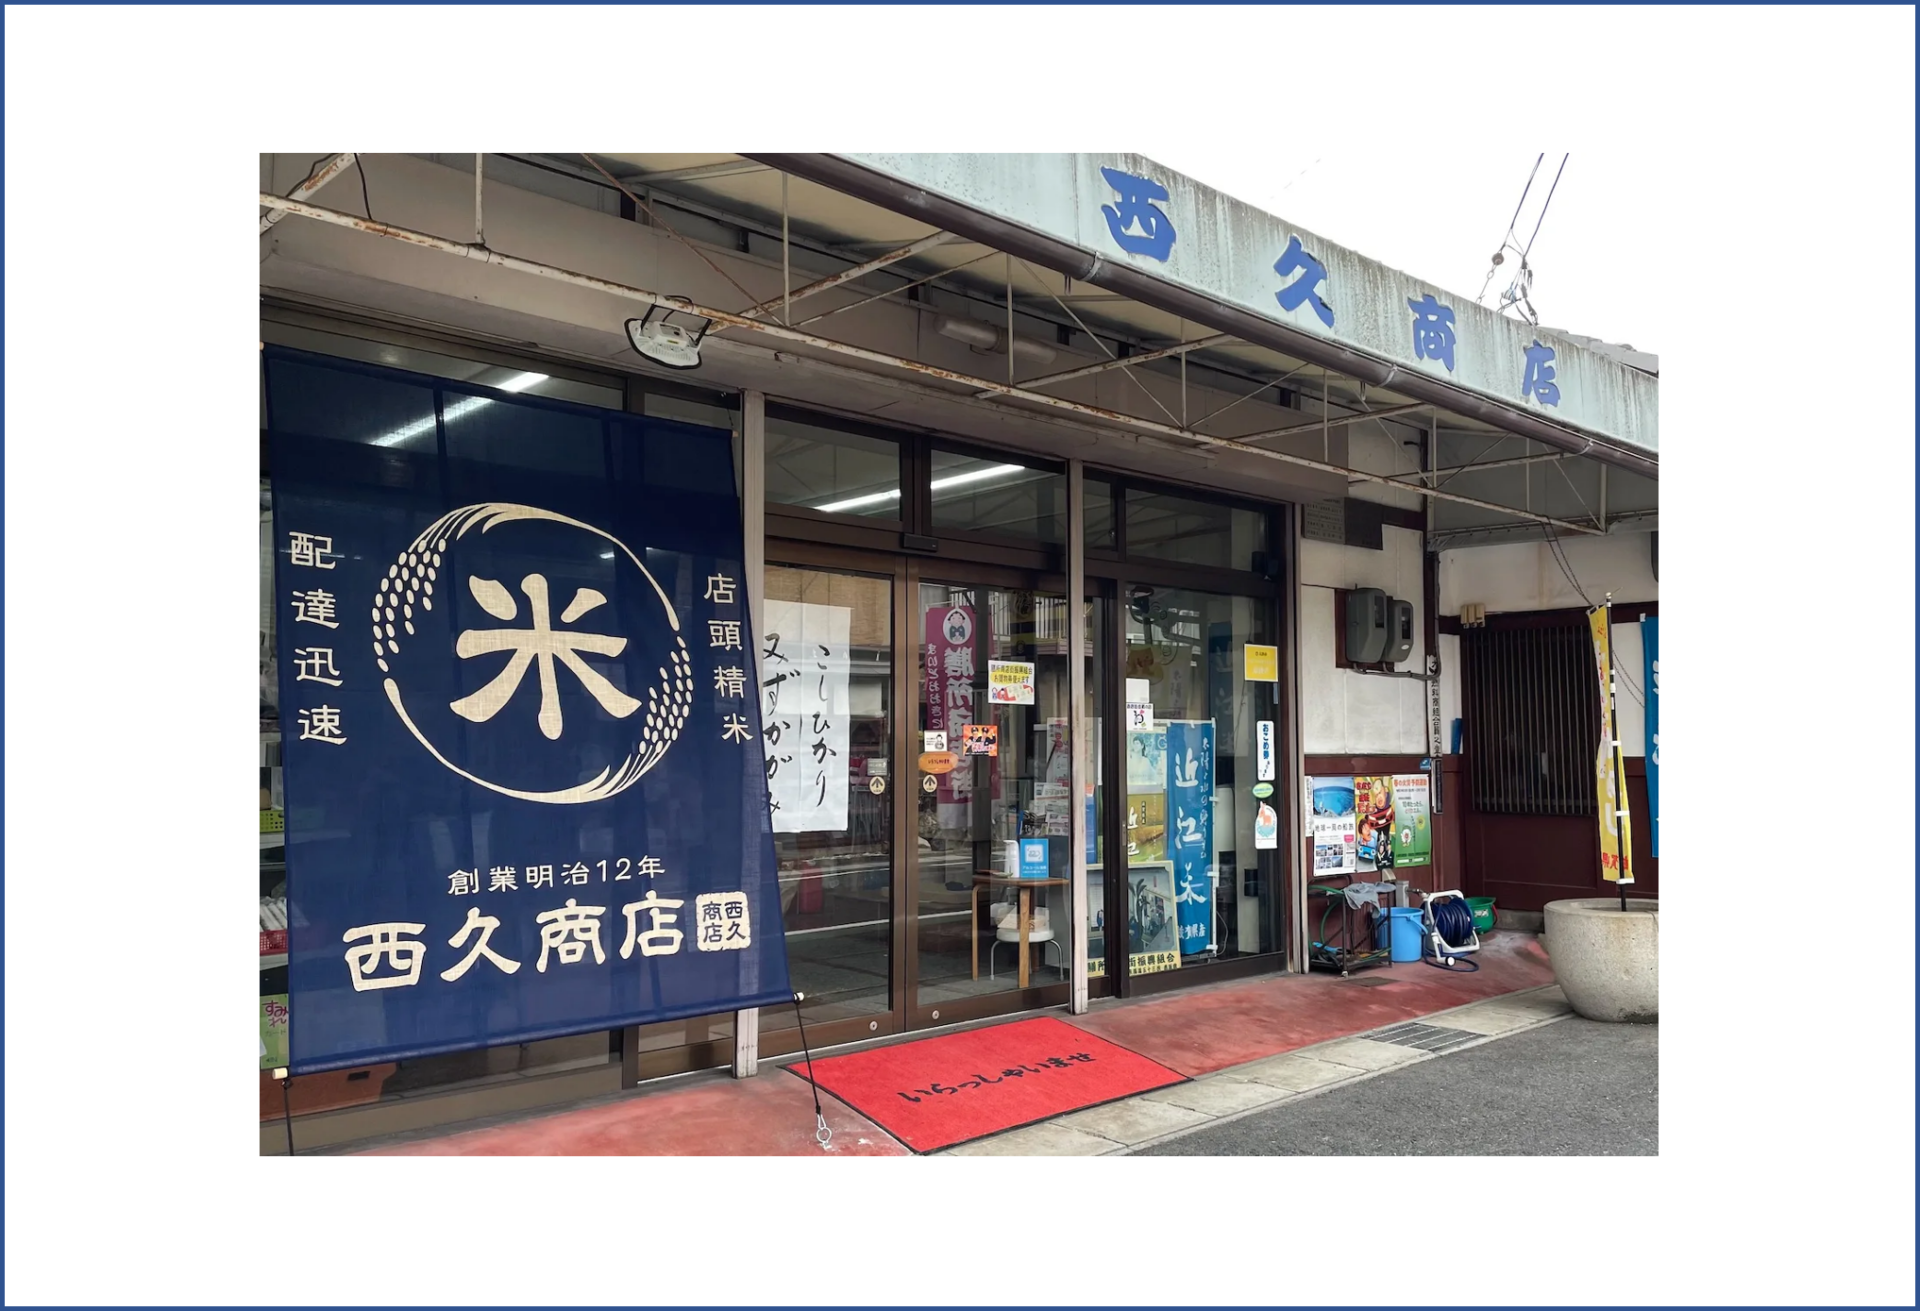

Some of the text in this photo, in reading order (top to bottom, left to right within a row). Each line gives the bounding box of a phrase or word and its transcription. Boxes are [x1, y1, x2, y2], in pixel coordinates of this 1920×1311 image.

[1100, 166, 1561, 407] 西久商店
[289, 531, 347, 745] 配達迅速
[450, 573, 642, 740] 米
[704, 573, 753, 744] 店頭精米
[812, 645, 837, 807] こしひかり
[447, 855, 666, 896] 創業明治12年
[1175, 747, 1208, 905] 近江米
[342, 890, 684, 992] 西久商店
[702, 901, 723, 942] 商店
[724, 901, 748, 940] 西久
[897, 1052, 1097, 1102] いらっしゃいませ
